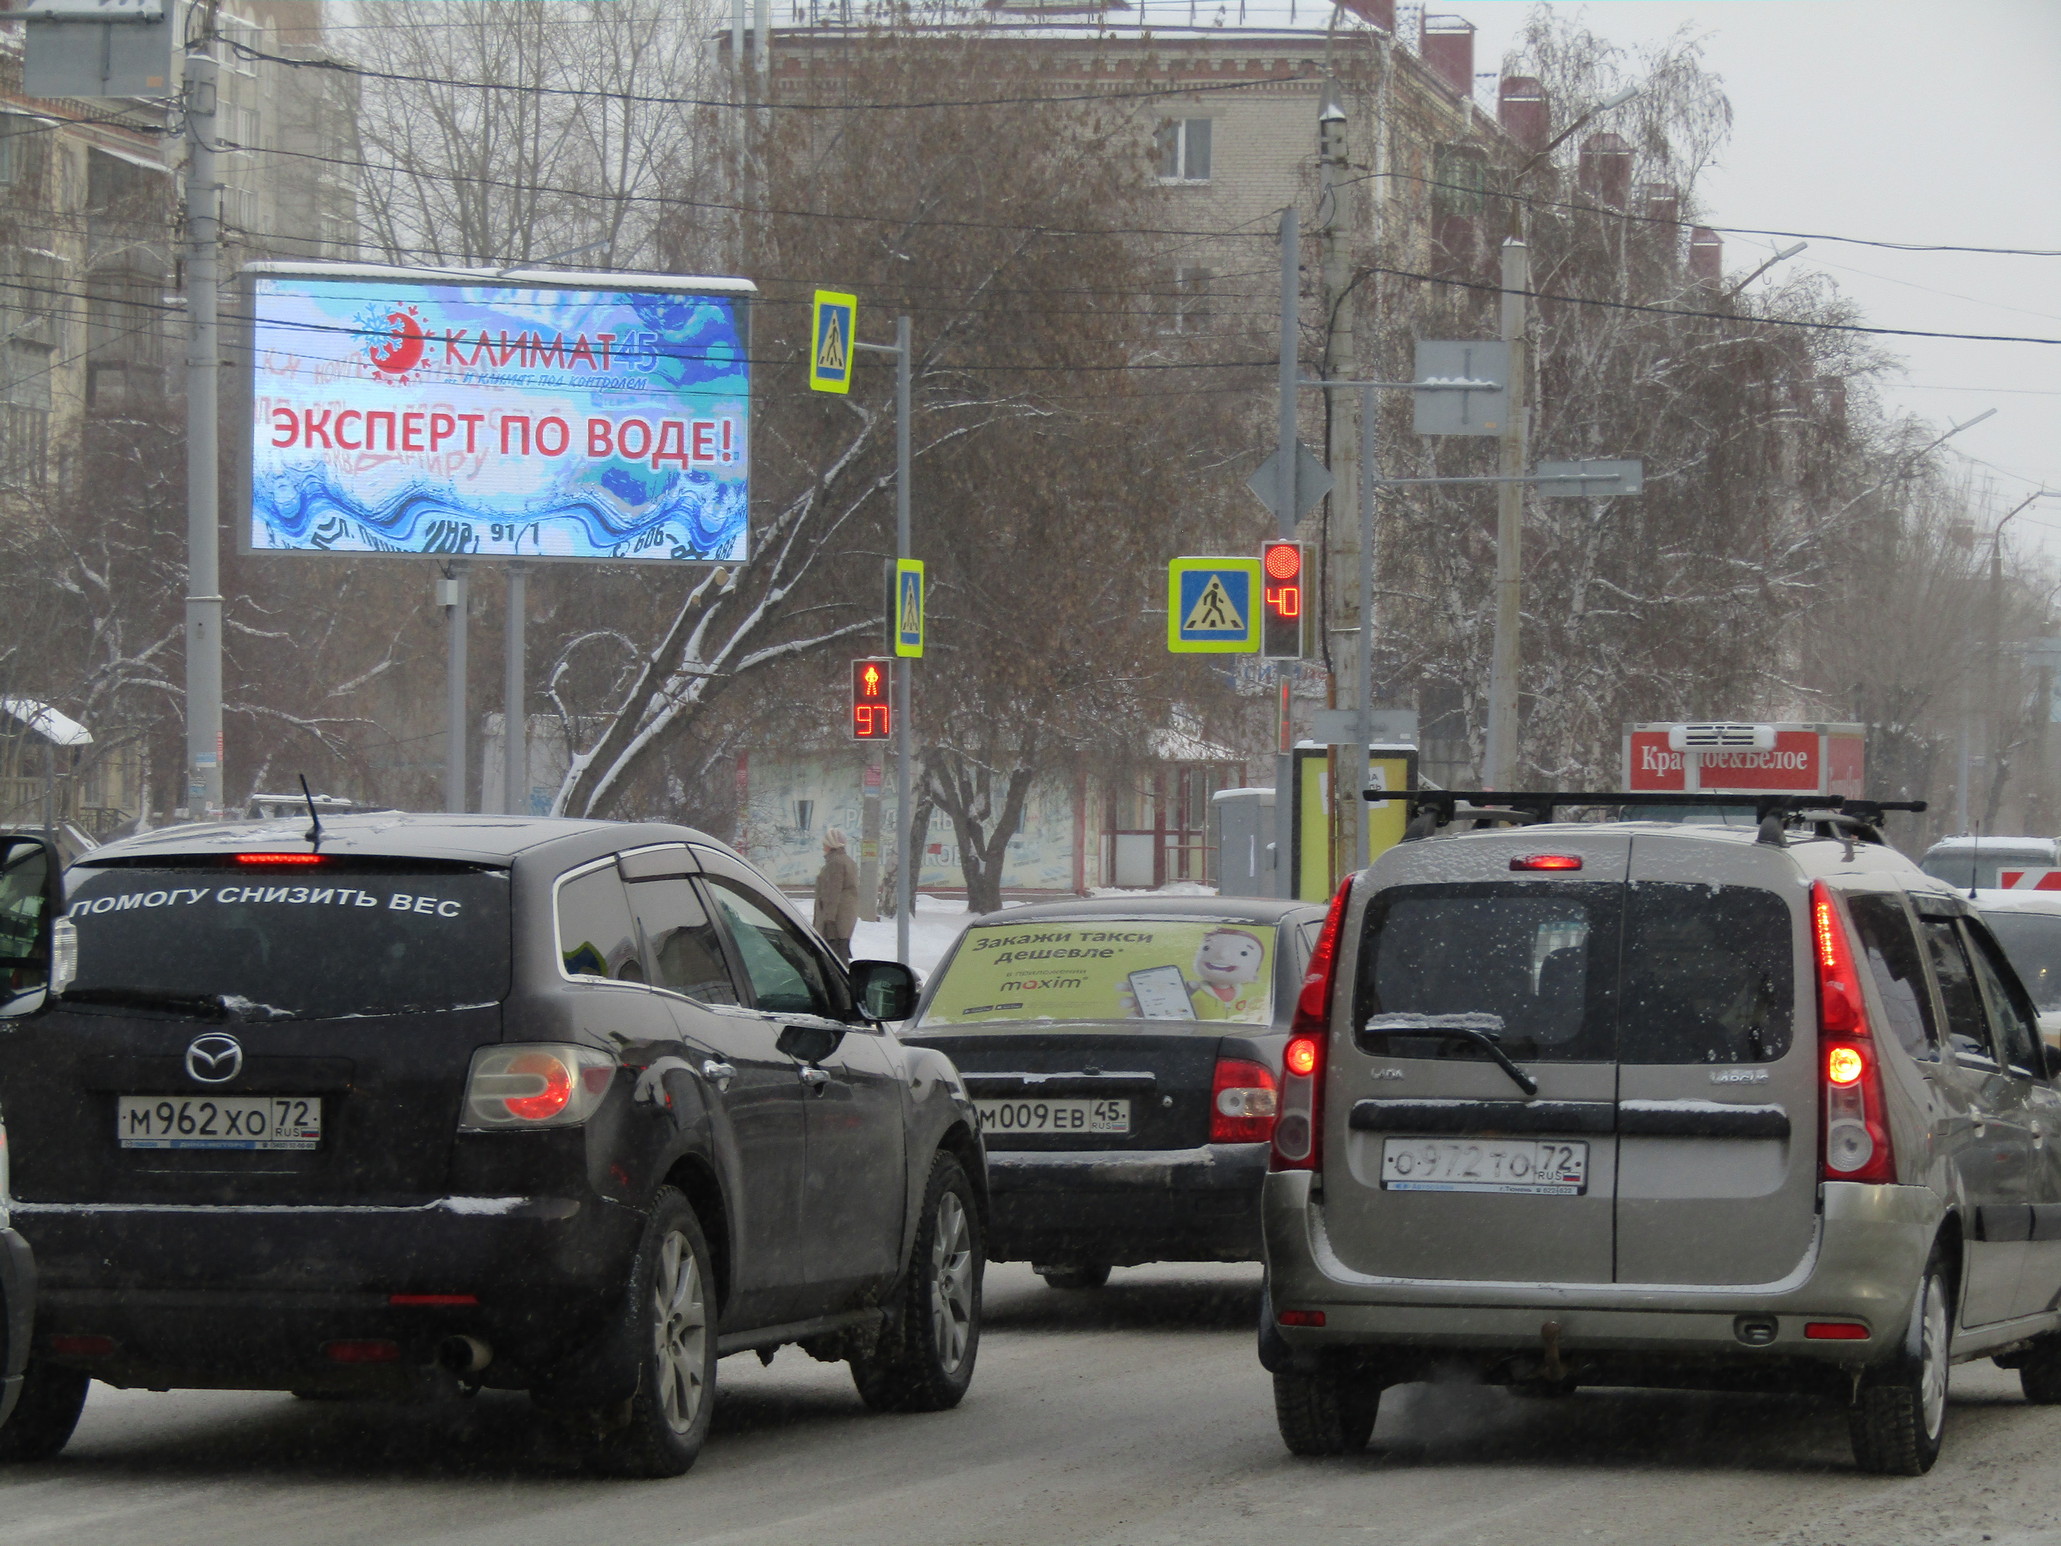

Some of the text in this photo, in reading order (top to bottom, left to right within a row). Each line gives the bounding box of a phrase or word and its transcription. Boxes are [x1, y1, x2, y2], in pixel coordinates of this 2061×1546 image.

[271, 407, 486, 455] ЭКСПЕРТ
[501, 415, 571, 458] ПО
[587, 418, 732, 471] ВОДЕ!
[1266, 587, 1299, 617] 40
[856, 705, 889, 736] 97
[1640, 745, 1808, 777] Краое&Белое
[69, 886, 463, 919] ПОМОГУ СНИЗИТЬ ВЕС
[972, 931, 1154, 952] Закажи такси
[275, 1100, 309, 1127] 72
[1094, 1101, 1120, 1122] 45
[275, 1127, 300, 1138] RUS
[1091, 1122, 1112, 1130] RUS
[1541, 1145, 1574, 1172] 72
[1537, 1171, 1562, 1181] RUS
